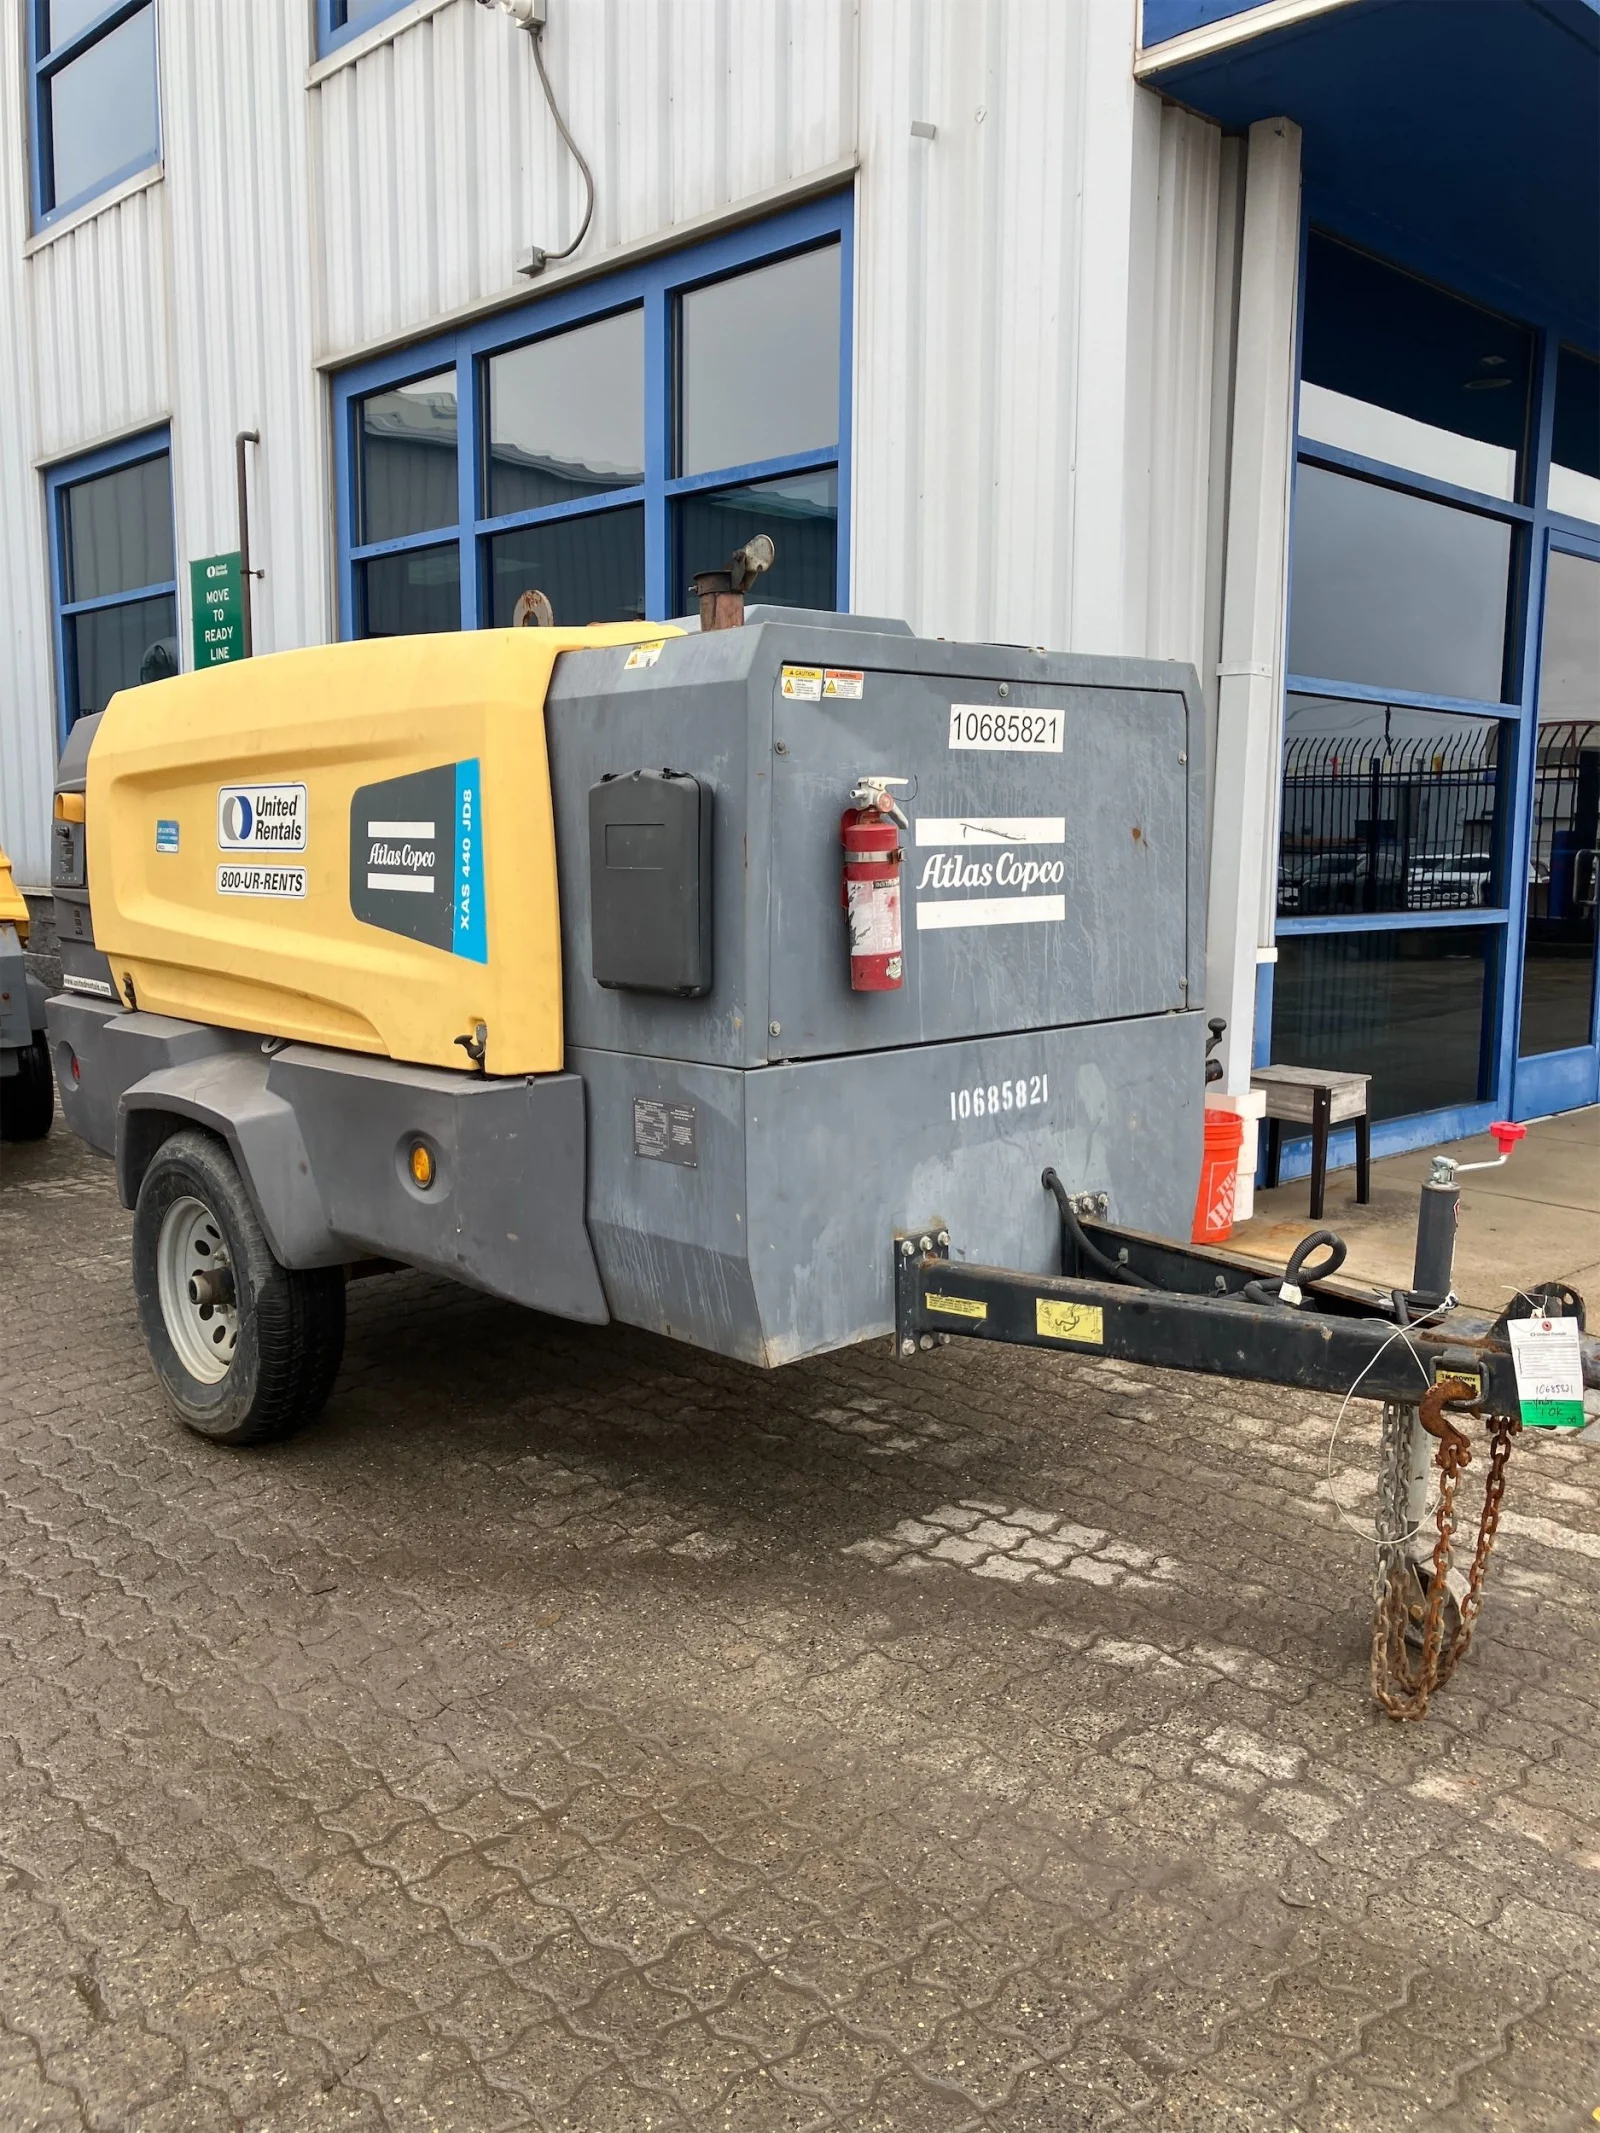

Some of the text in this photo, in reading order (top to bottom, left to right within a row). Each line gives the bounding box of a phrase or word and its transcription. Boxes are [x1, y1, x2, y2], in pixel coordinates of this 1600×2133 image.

[206, 588, 229, 604] MOVE
[213, 609, 224, 622] TO
[205, 626, 233, 643] READY
[210, 647, 229, 661] LINE
[953, 712, 1057, 744] 10685821
[256, 795, 298, 817] United
[255, 819, 302, 841] Rentals
[367, 843, 435, 872] Atlas Copco
[460, 788, 472, 930] XAS 440 JD8
[221, 871, 303, 892] 800-UR-RENTS
[916, 852, 1064, 892] Atlas Copco
[950, 1074, 1048, 1121] 10685821
[1208, 1188, 1234, 1228] HO
